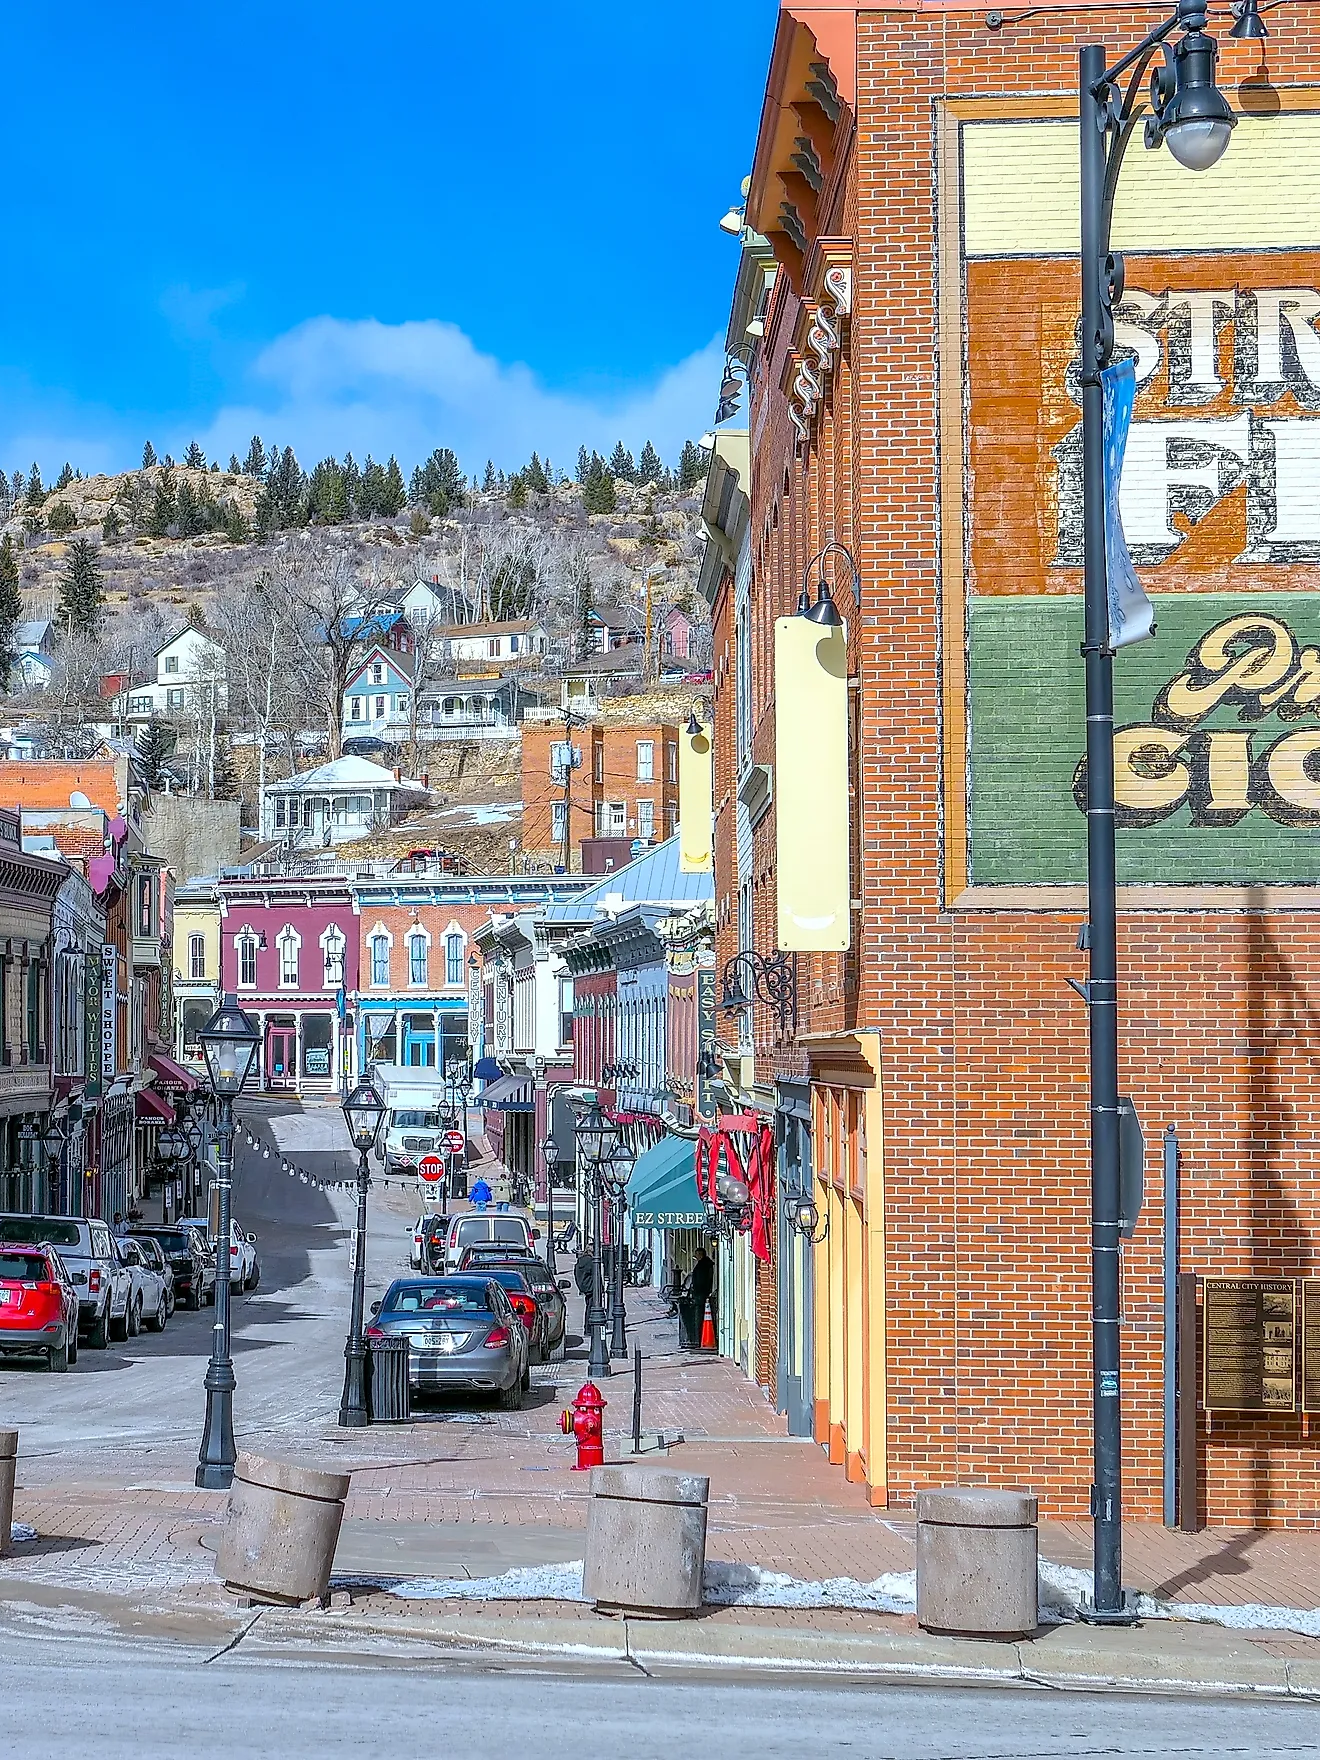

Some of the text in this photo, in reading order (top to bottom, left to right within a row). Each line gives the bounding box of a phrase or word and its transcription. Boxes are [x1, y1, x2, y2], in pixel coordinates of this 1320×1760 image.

[87, 957, 100, 1082] MAYOR WILLIES
[102, 947, 115, 1073] SWEET SHOPPE
[470, 970, 480, 1042] CENTURY
[497, 963, 507, 1048] CENTURY
[700, 974, 716, 1021] EASY
[419, 1163, 443, 1174] STOP
[635, 1212, 706, 1225] EZ STREE
[1206, 1282, 1240, 1290] CENTRAL
[1260, 1283, 1293, 1291] HISTORY
